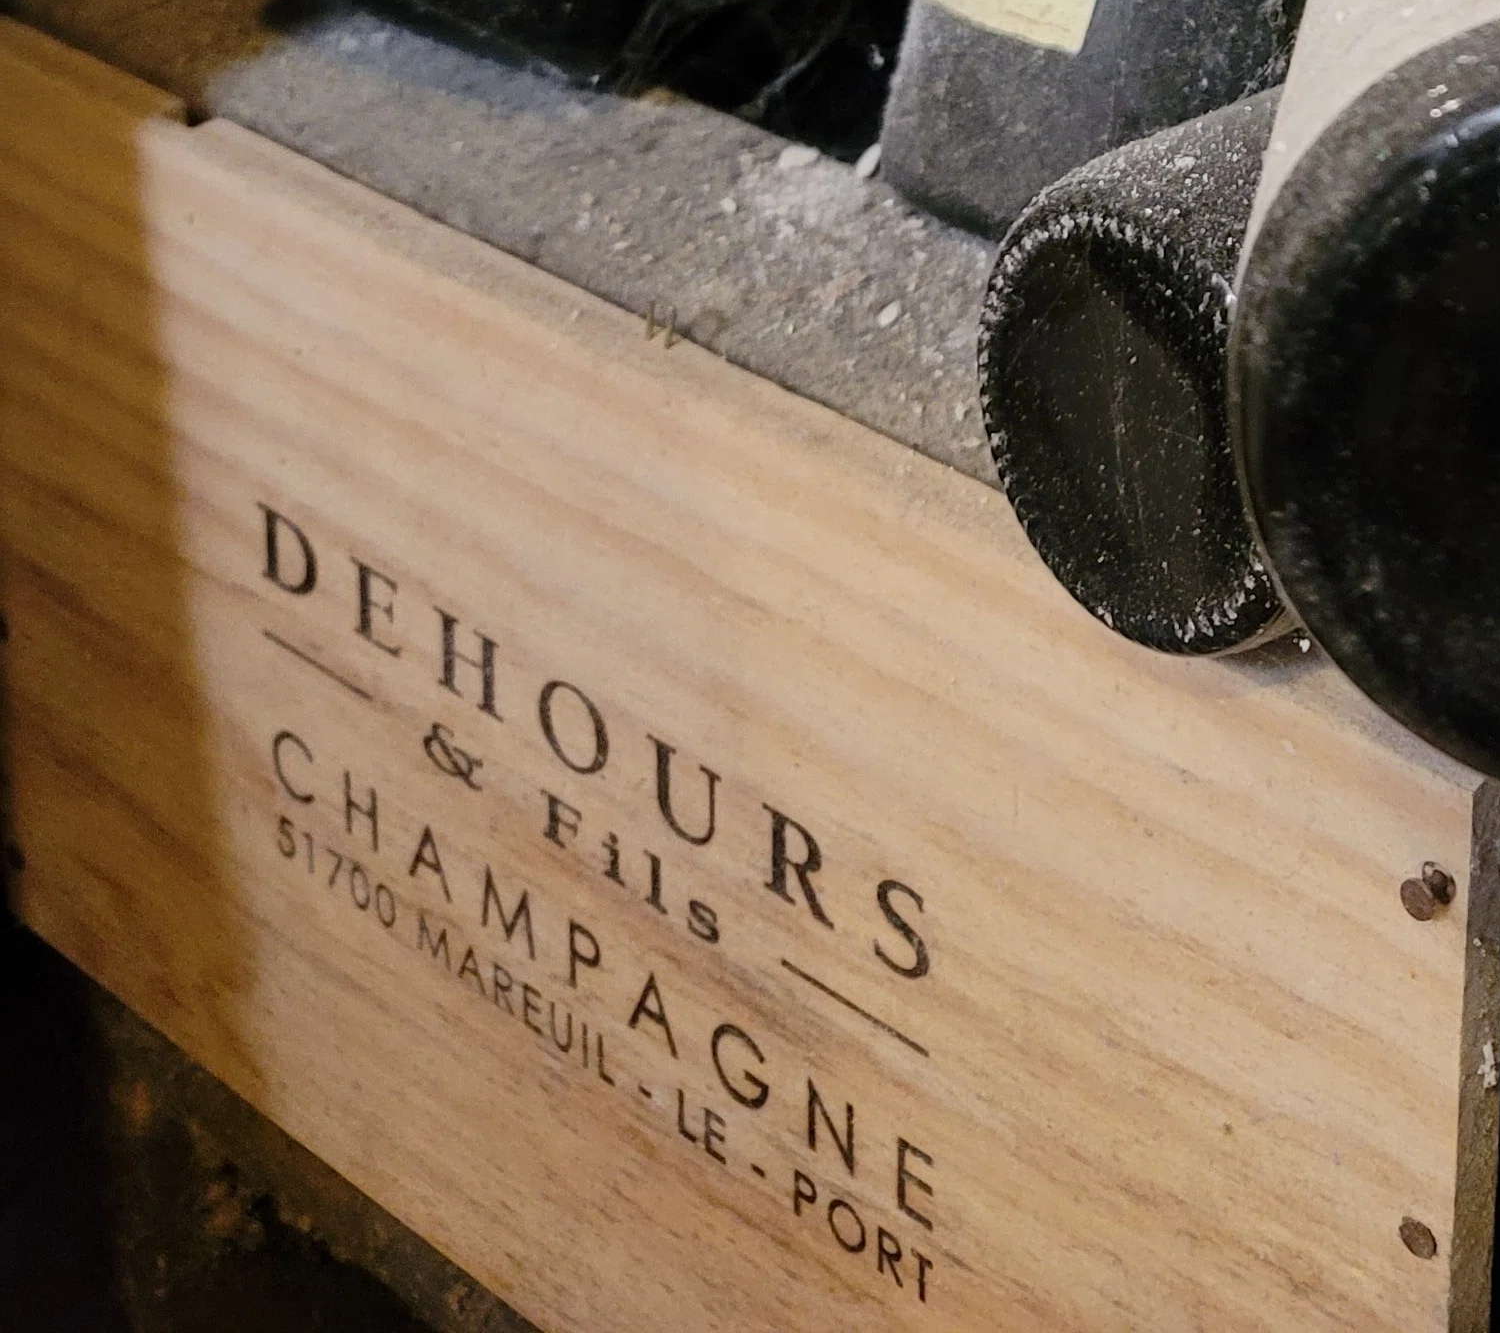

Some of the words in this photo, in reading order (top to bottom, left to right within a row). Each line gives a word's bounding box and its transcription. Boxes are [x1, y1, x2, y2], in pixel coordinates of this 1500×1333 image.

[255, 500, 932, 982] DEHOURS
[275, 815, 398, 929] 51700
[422, 721, 484, 791] &
[540, 786, 722, 944] Fils
[272, 730, 936, 1234] CHAMPAGNE
